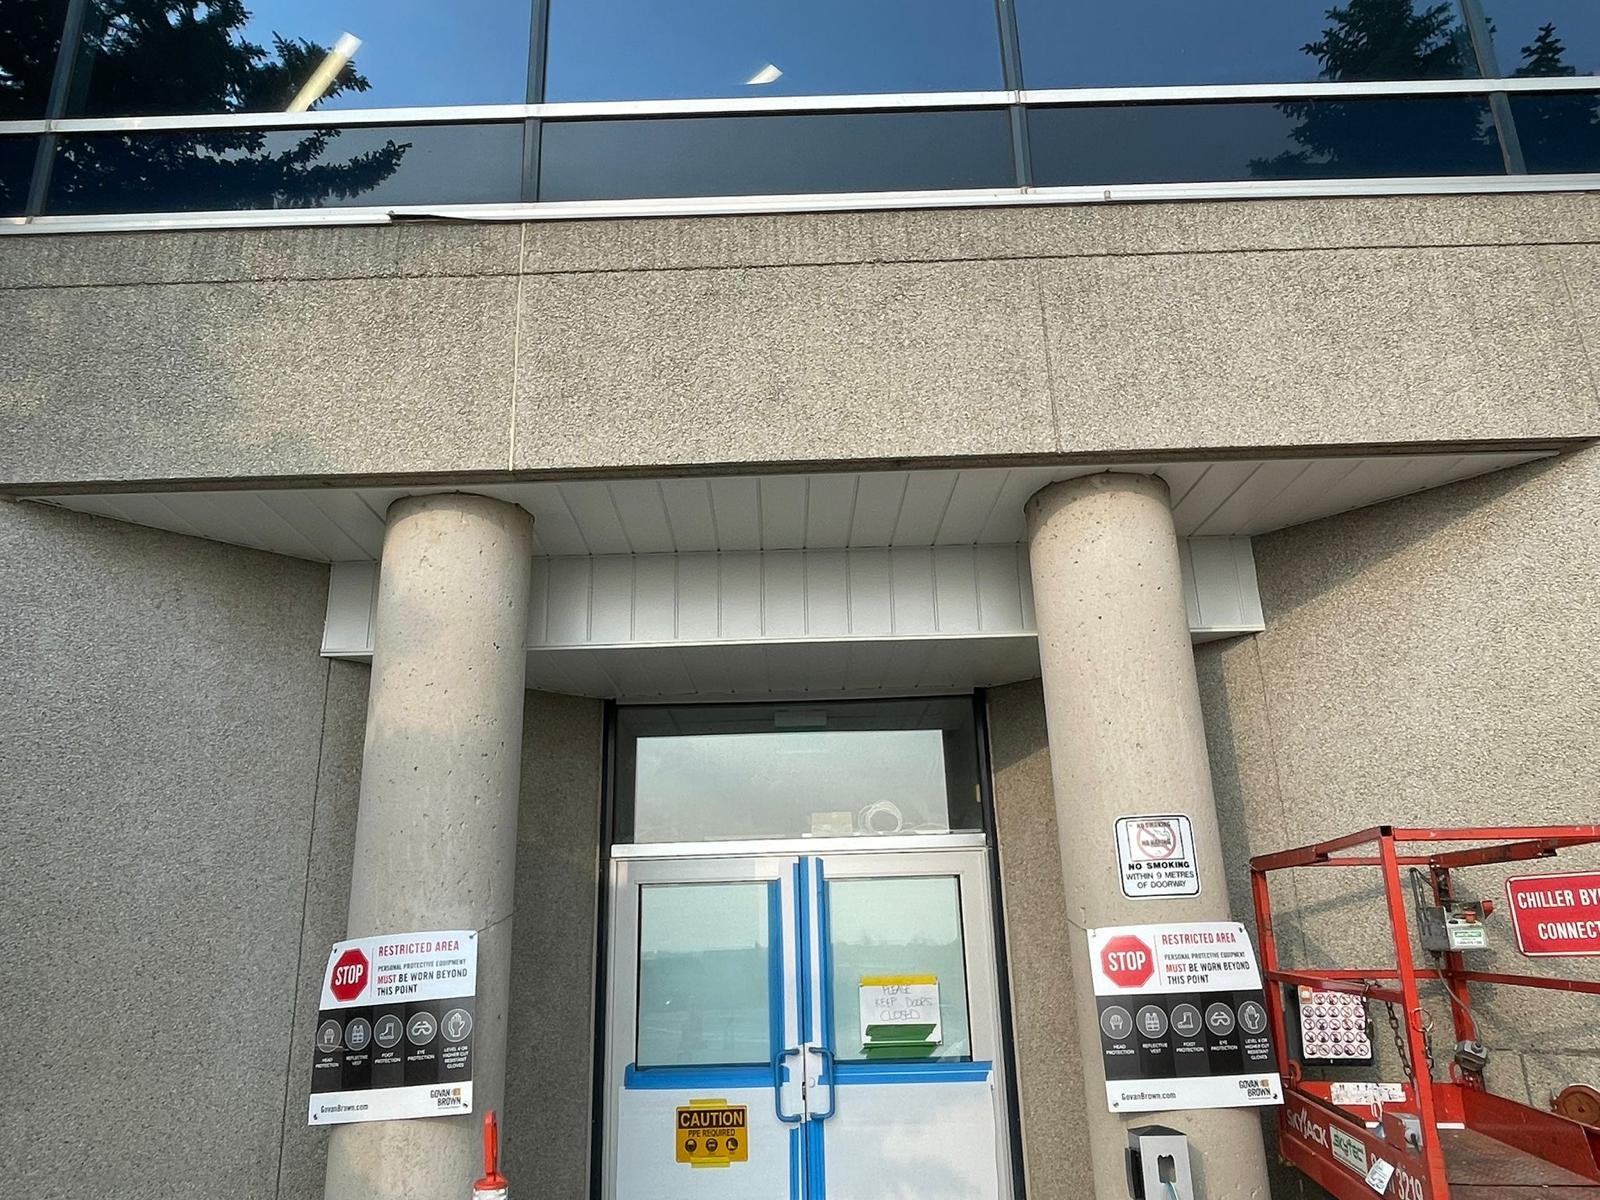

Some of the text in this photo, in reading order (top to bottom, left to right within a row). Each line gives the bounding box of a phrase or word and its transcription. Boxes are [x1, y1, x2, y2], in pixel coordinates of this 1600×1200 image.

[1128, 861, 1190, 871] NO SMOKING
[1126, 872, 1154, 880] WITHIN
[1150, 880, 1186, 888] DOORWAY
[1517, 888, 1600, 909] CHILLER BY
[1162, 932, 1236, 945] RESTRICTED AREA
[378, 940, 460, 957] RESTRICTED AREA
[1107, 951, 1146, 972] STOP
[1191, 952, 1220, 960] PROTECTIVE
[378, 958, 466, 972] PERSONAL PROTECTIVE EQUIPMENT
[1166, 962, 1250, 973] MUST BE WORN BEYOND
[335, 964, 363, 986] STOP
[377, 968, 468, 985] MUST BE WORN BEYOND
[1167, 974, 1209, 985] THIS POINT
[377, 984, 418, 997] THIS POINT
[880, 1009, 920, 1021] CLOSED
[1238, 1080, 1260, 1089] GOVAN
[430, 1088, 451, 1099] GOVAN
[1121, 1092, 1177, 1102] GovanBrown.com
[1247, 1087, 1272, 1098] BROWN
[437, 1097, 462, 1106] BROWN
[320, 1104, 369, 1114] GovanBrown.com
[680, 1111, 743, 1127] CAUTION
[688, 1128, 736, 1138] PPE REQUIRED
